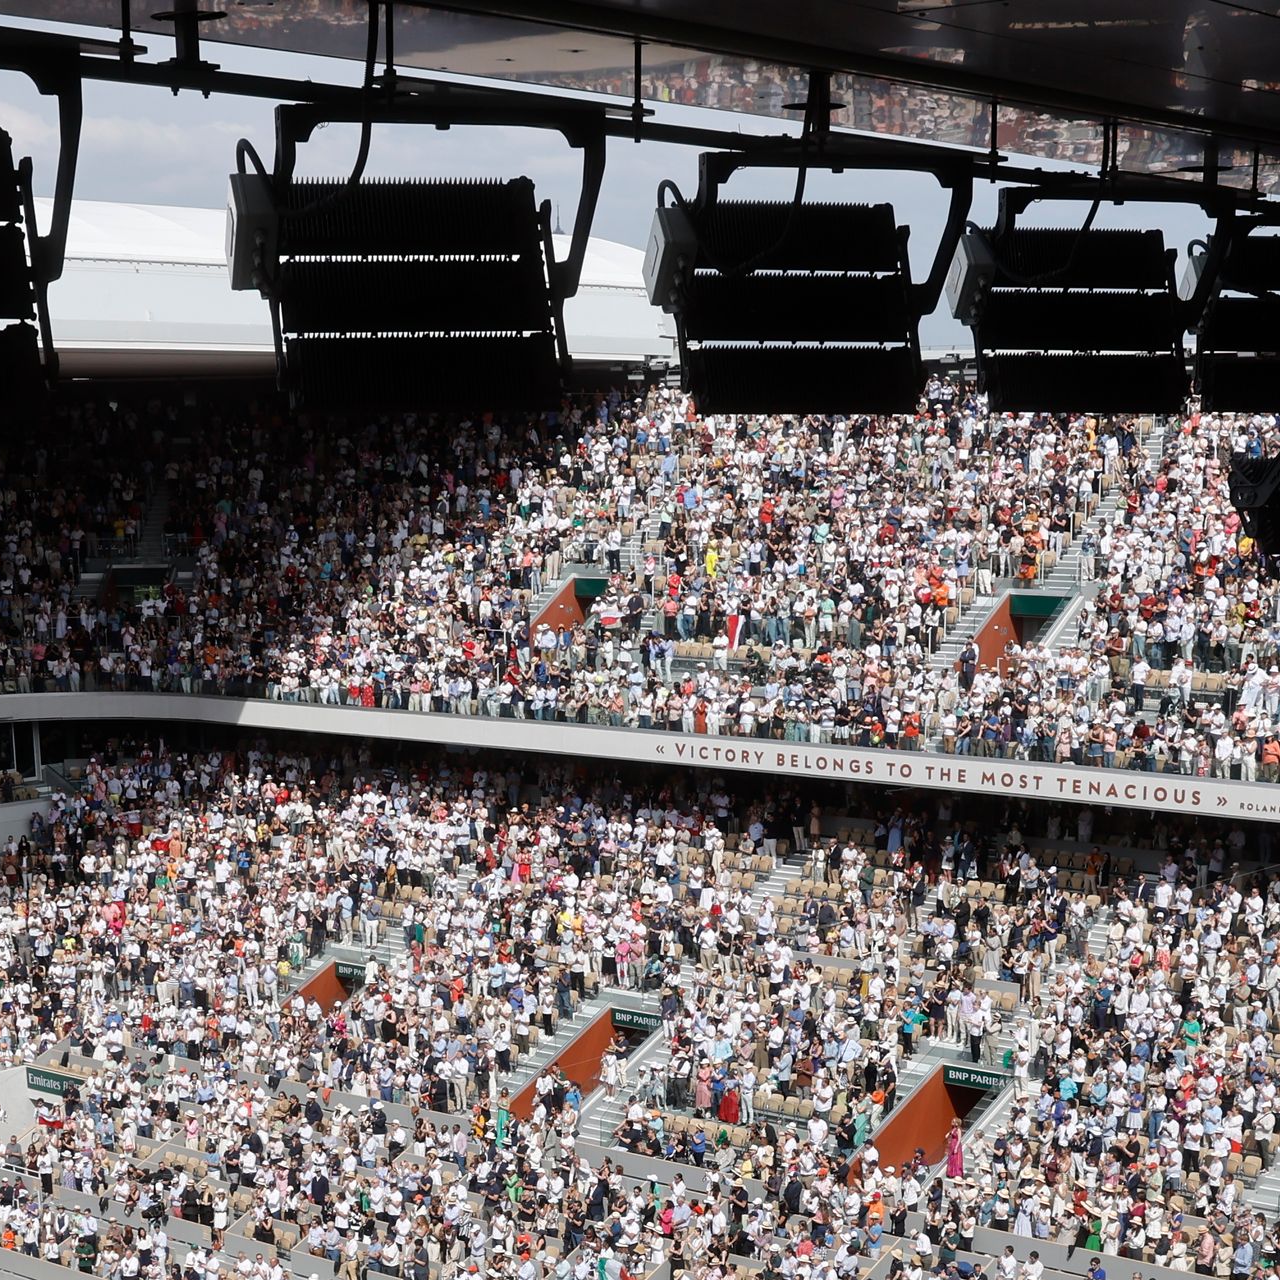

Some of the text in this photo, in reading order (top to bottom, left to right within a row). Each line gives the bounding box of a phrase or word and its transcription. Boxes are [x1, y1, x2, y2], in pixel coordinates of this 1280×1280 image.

[675, 743, 764, 764] VICTORY
[776, 753, 874, 774] BELONGS
[886, 763, 913, 778] TO
[925, 766, 967, 783] THE
[981, 772, 1043, 790] MOST
[1057, 778, 1201, 806] TENACIOUS
[615, 1012, 662, 1027] BNP PARIBA
[28, 1072, 61, 1090] Emirates
[948, 1070, 969, 1081] BNP
